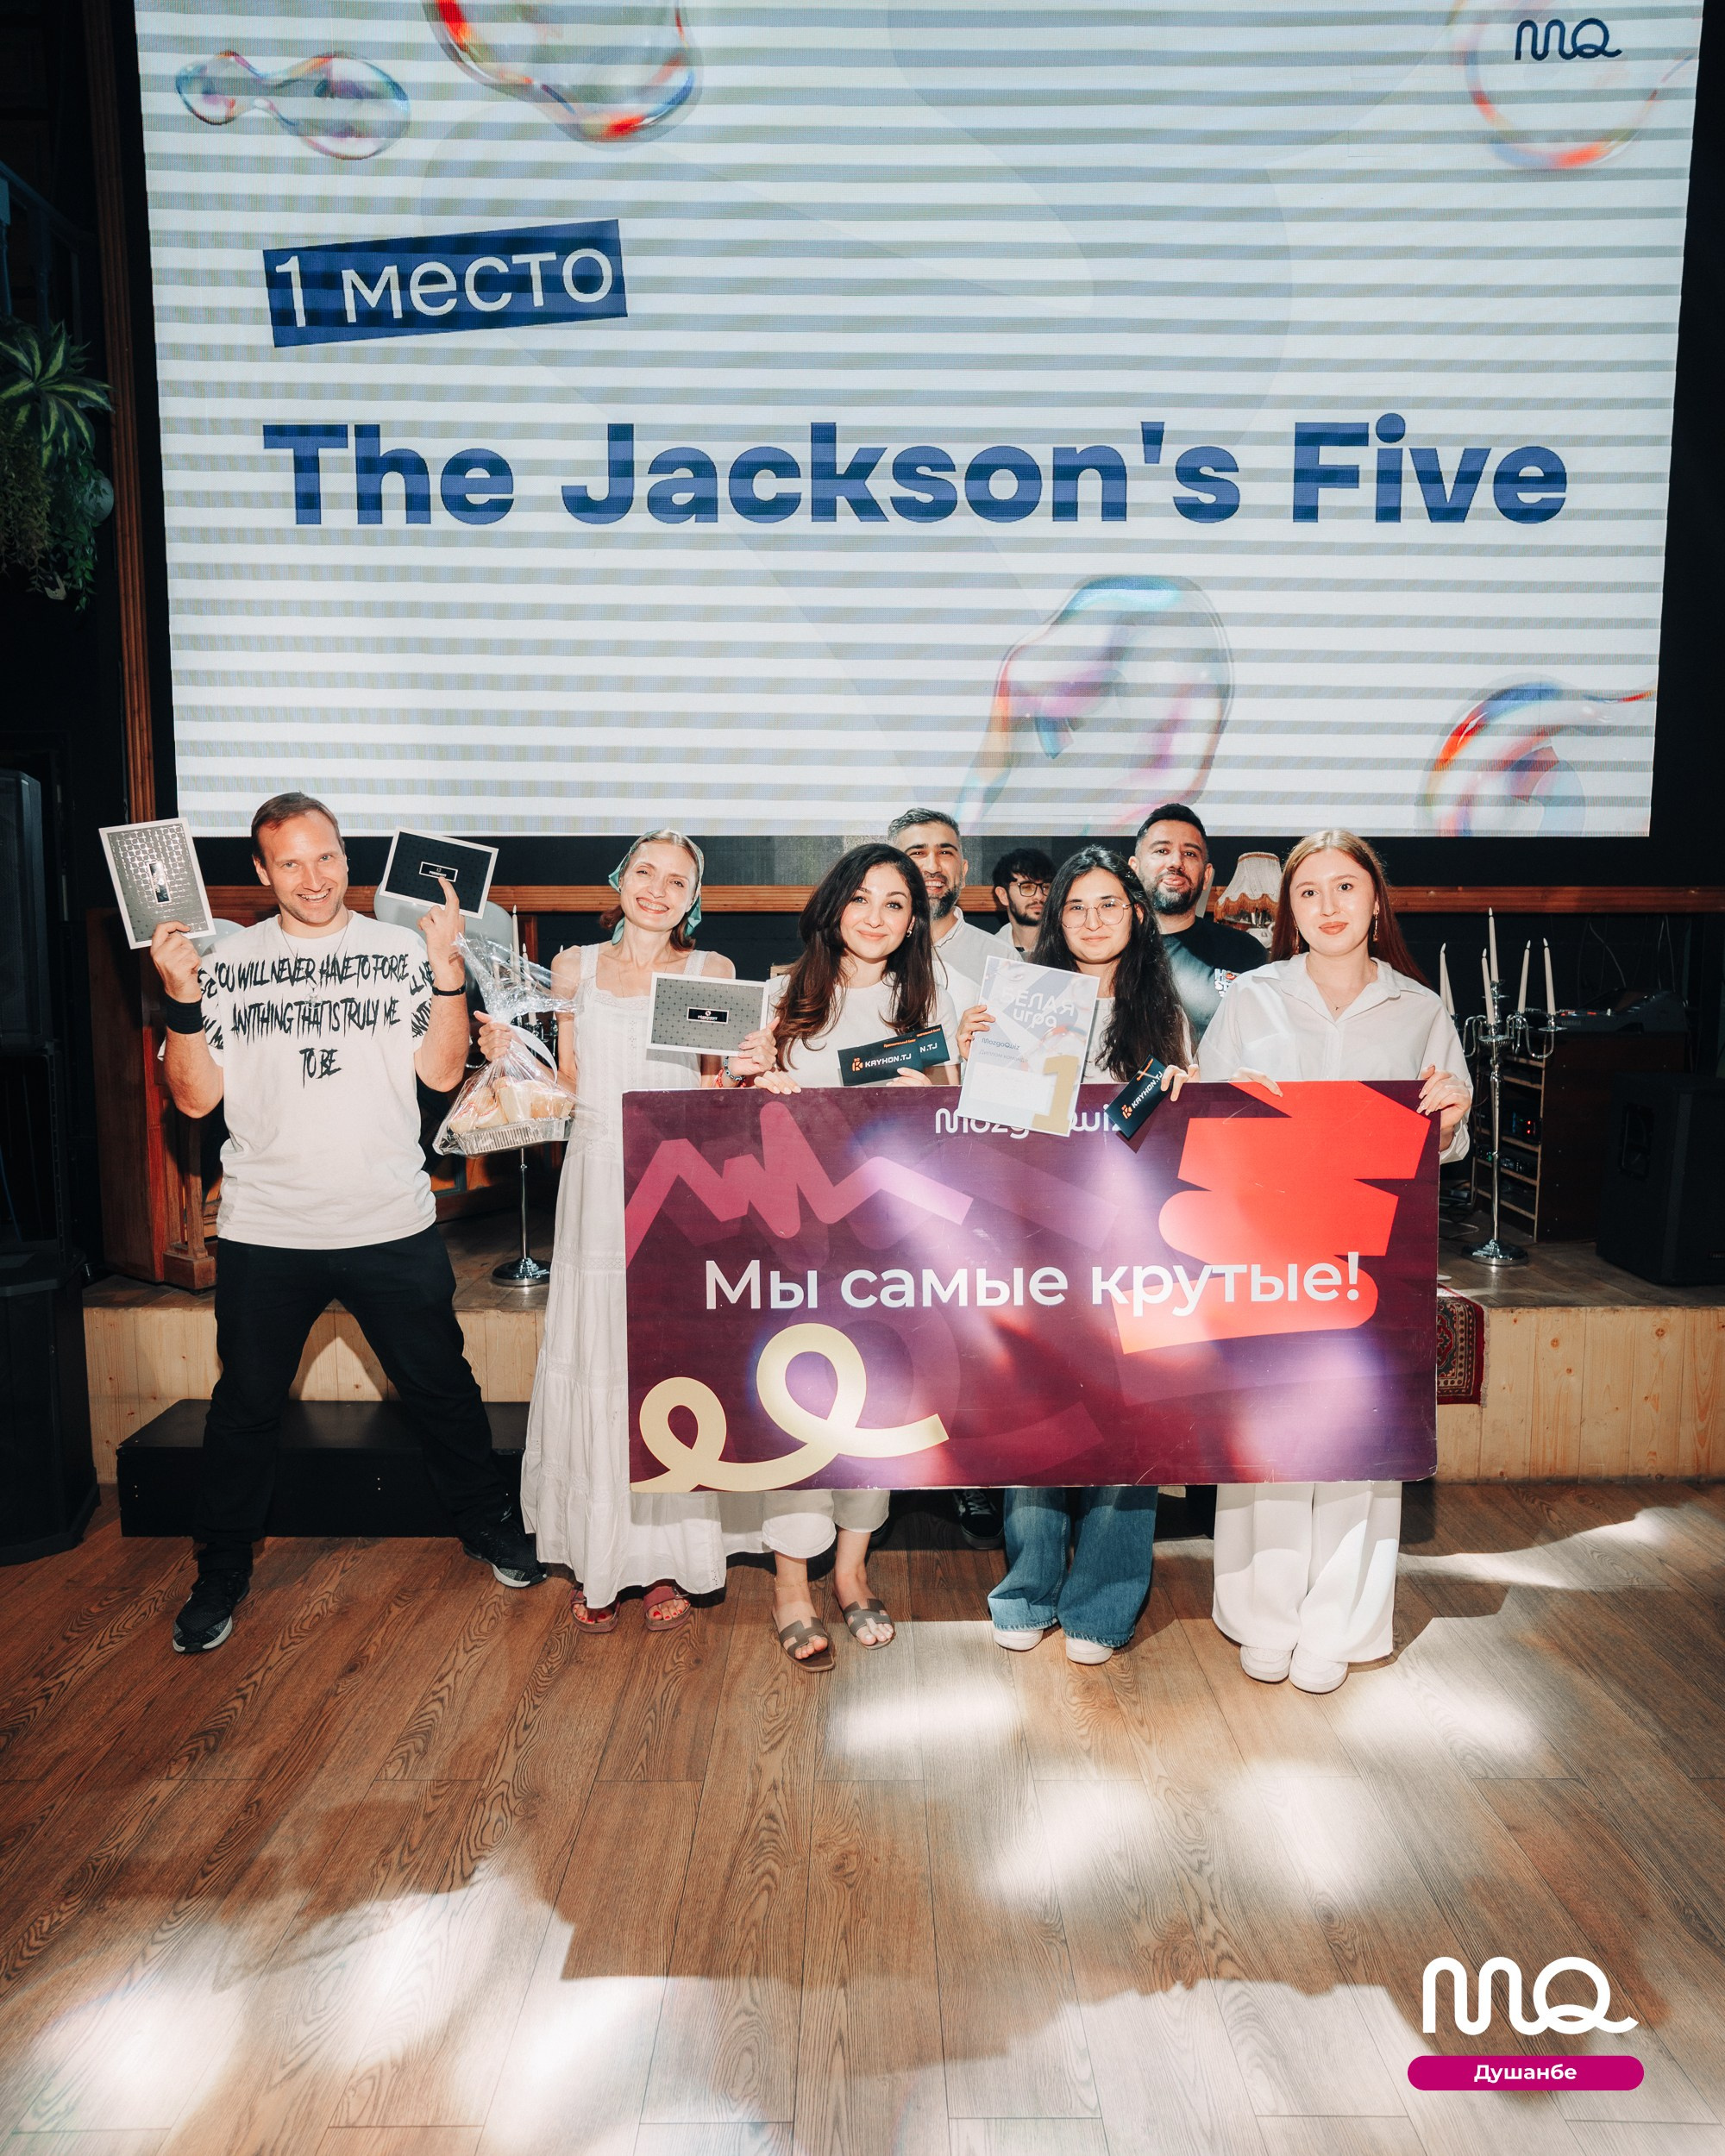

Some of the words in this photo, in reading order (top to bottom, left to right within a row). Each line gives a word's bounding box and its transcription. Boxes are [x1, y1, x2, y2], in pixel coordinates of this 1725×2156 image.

[275, 254, 307, 328] 1
[341, 248, 613, 323] место
[263, 423, 515, 525] The
[561, 421, 1240, 525] Jackson's
[1293, 412, 1568, 525] Five
[238, 959, 270, 991] WILL
[271, 950, 317, 987] NEVER
[319, 948, 357, 989] HAVE
[354, 954, 370, 988] TO
[372, 953, 409, 984] FORCE
[230, 997, 294, 1044] ANYTHING
[293, 1000, 328, 1039] THAT
[340, 997, 380, 1037] TRULY
[383, 996, 401, 1031] ME
[1000, 985, 1076, 1017] БЕЛАЯ
[1013, 1007, 1057, 1029] игра
[298, 1047, 317, 1087] TO
[316, 1048, 342, 1079] BE
[864, 1053, 912, 1069] KAYHON.TJ
[1032, 1054, 1080, 1135] 1
[705, 1259, 819, 1310] Мы
[840, 1263, 1067, 1308] самые
[1090, 1251, 1361, 1318] крутые!
